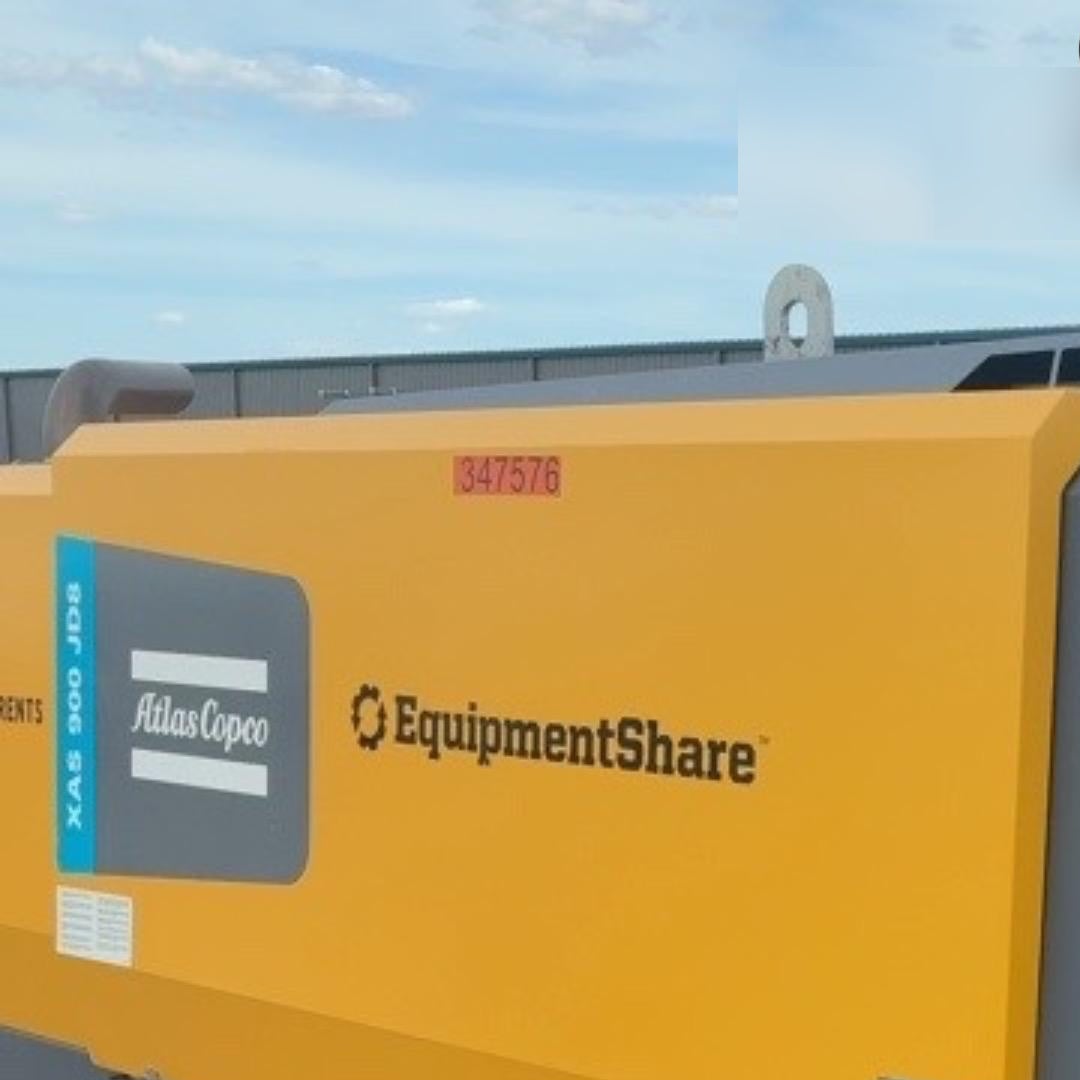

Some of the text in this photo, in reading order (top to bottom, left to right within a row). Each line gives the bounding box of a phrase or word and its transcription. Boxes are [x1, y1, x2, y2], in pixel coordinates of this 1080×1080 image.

[461, 456, 560, 494] 347576
[67, 667, 83, 735] 900
[131, 692, 269, 752] Atlas Copco
[394, 695, 756, 784] EquipmentShare
[66, 749, 83, 830] XAS
